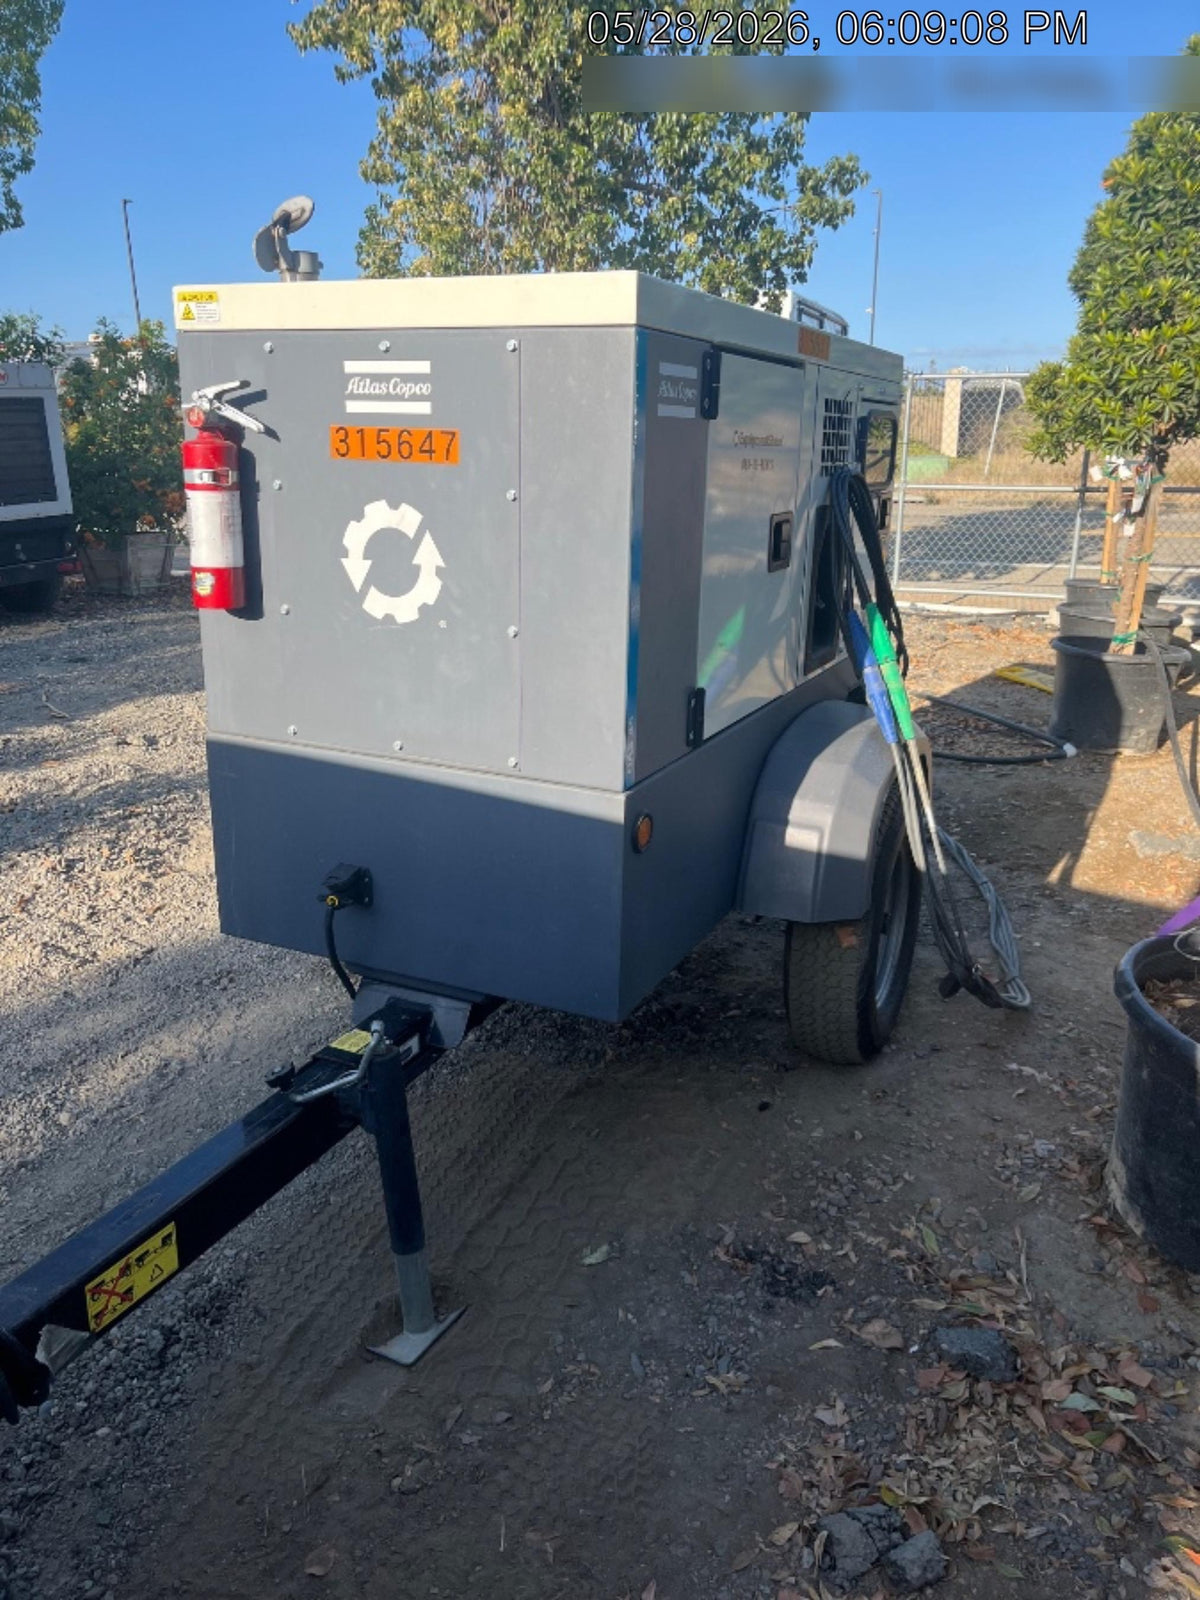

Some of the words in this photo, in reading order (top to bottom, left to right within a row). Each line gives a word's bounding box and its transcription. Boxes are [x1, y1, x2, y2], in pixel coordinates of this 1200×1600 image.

[345, 376, 388, 395] Atlas
[388, 377, 432, 399] Copco
[334, 426, 456, 461] 315647
